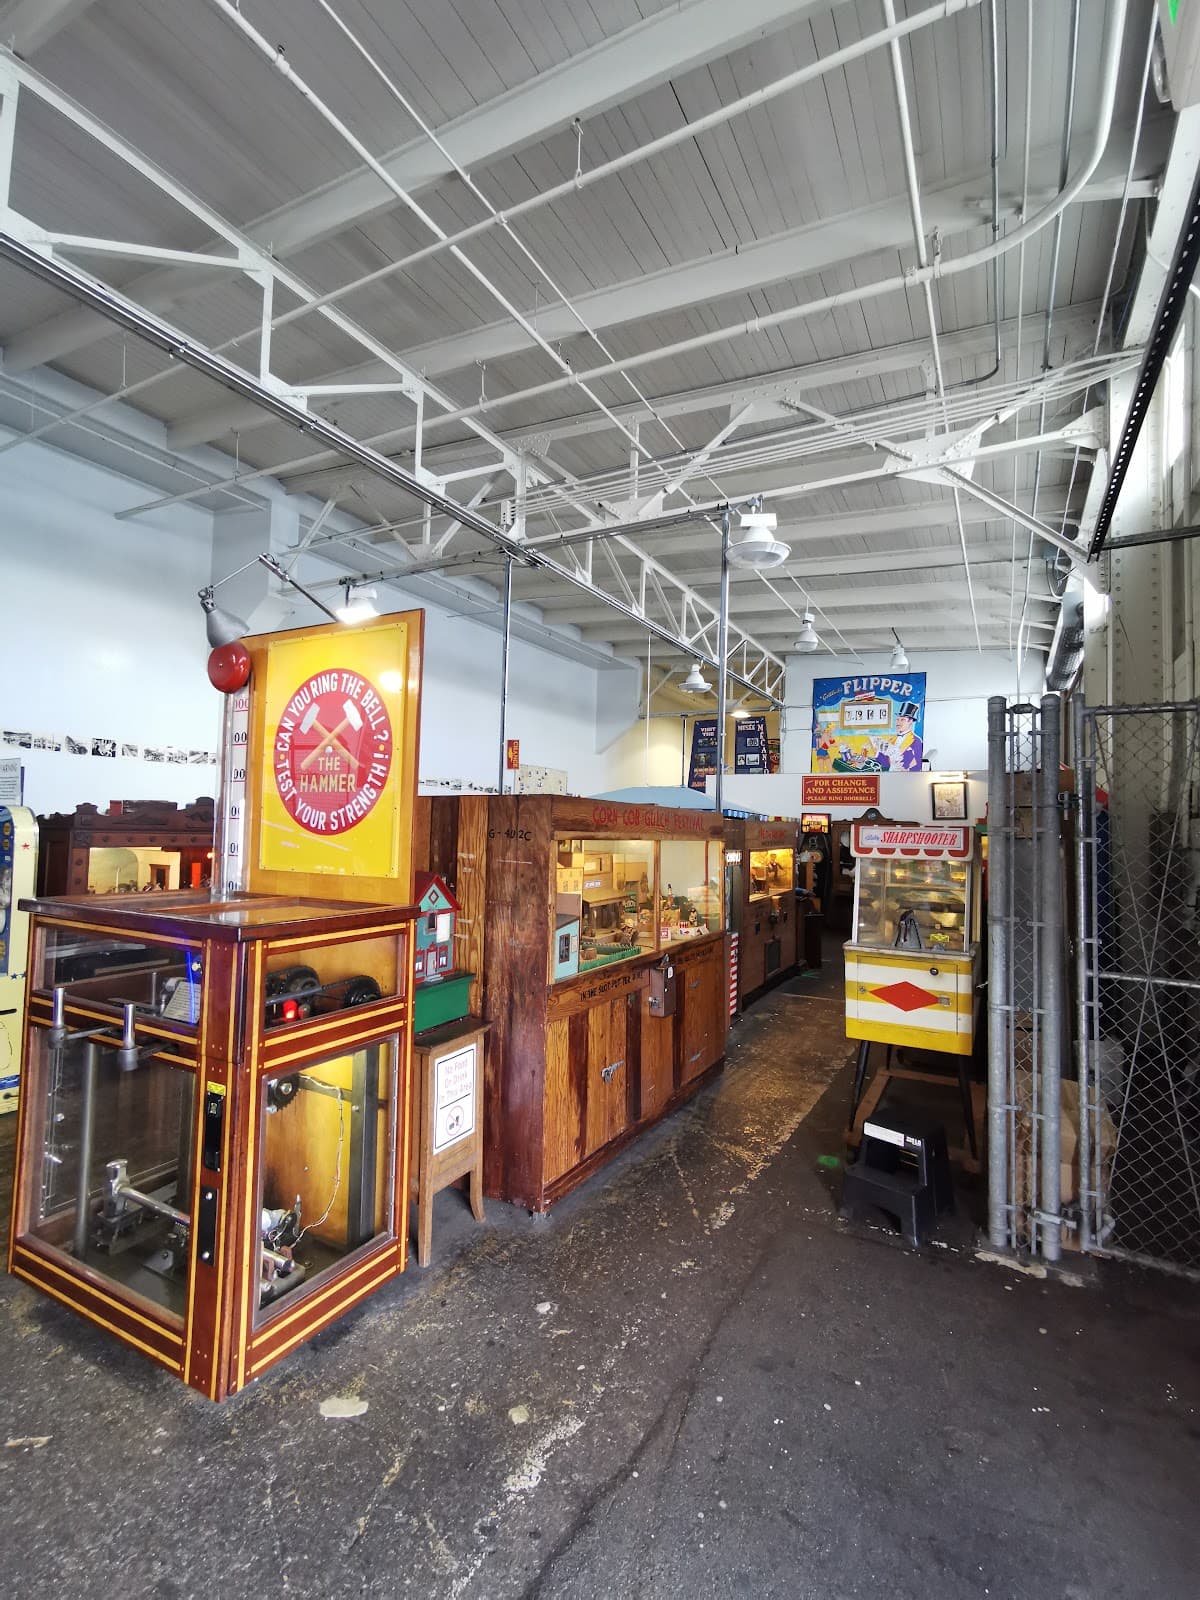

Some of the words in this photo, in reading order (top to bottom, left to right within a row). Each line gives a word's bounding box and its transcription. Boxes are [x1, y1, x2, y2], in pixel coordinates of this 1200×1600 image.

[842, 676, 913, 697] FLIPPER
[277, 717, 295, 752] CAN
[288, 687, 311, 717] YOU
[310, 673, 338, 698] RING
[341, 673, 365, 699] THE
[318, 757, 340, 771] THE
[300, 774, 356, 793] HAMMER
[276, 759, 297, 801] TEST
[295, 798, 327, 831] YOUR
[622, 808, 640, 826] COB
[881, 832, 957, 846] SHARPSHOOTER
